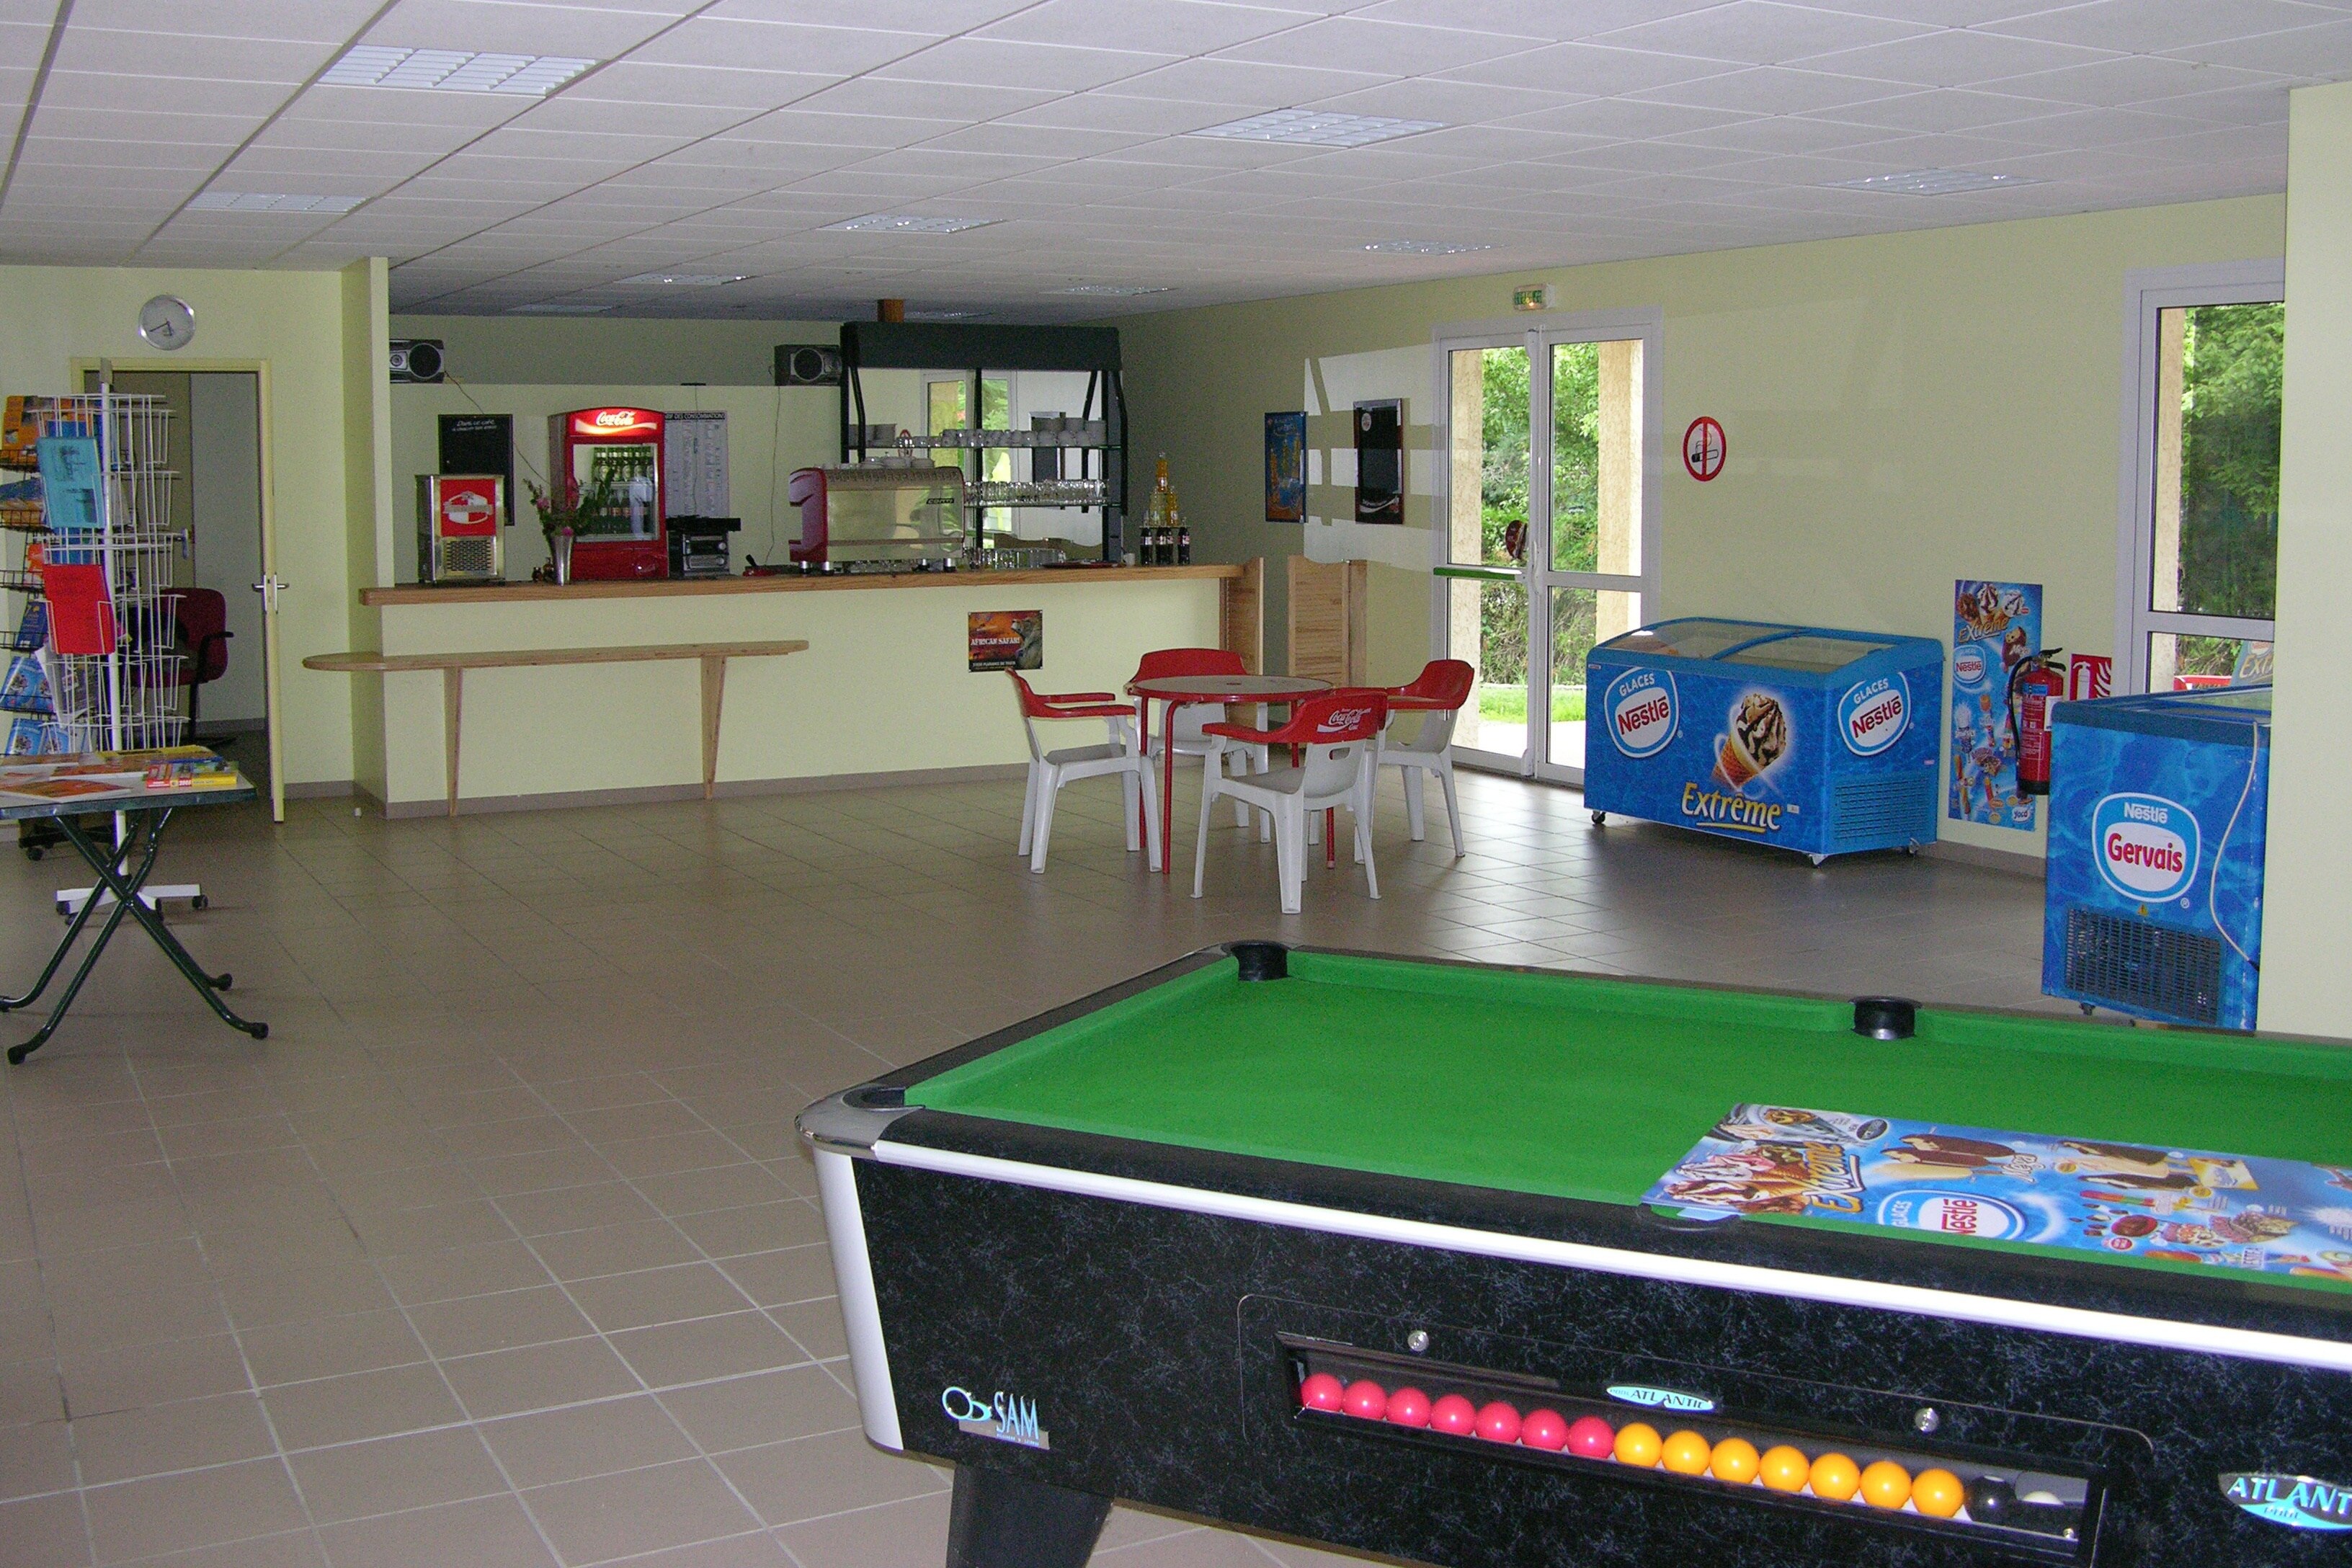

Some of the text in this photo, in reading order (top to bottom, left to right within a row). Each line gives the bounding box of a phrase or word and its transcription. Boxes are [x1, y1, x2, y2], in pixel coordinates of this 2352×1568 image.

[1619, 673, 1655, 697] GLACES
[1956, 661, 1982, 672] Nestlé
[1853, 678, 1889, 704] GLACES
[1618, 696, 1670, 735] Nestlé
[1852, 695, 1902, 738] Nestlé
[1682, 782, 1781, 829] Extrême
[2124, 802, 2168, 824] Nestlé
[2108, 832, 2183, 873] Gervais
[1803, 1141, 1865, 1213] Extrême
[994, 1391, 1039, 1440] SAM
[1631, 1390, 1705, 1409] ATLANTIC
